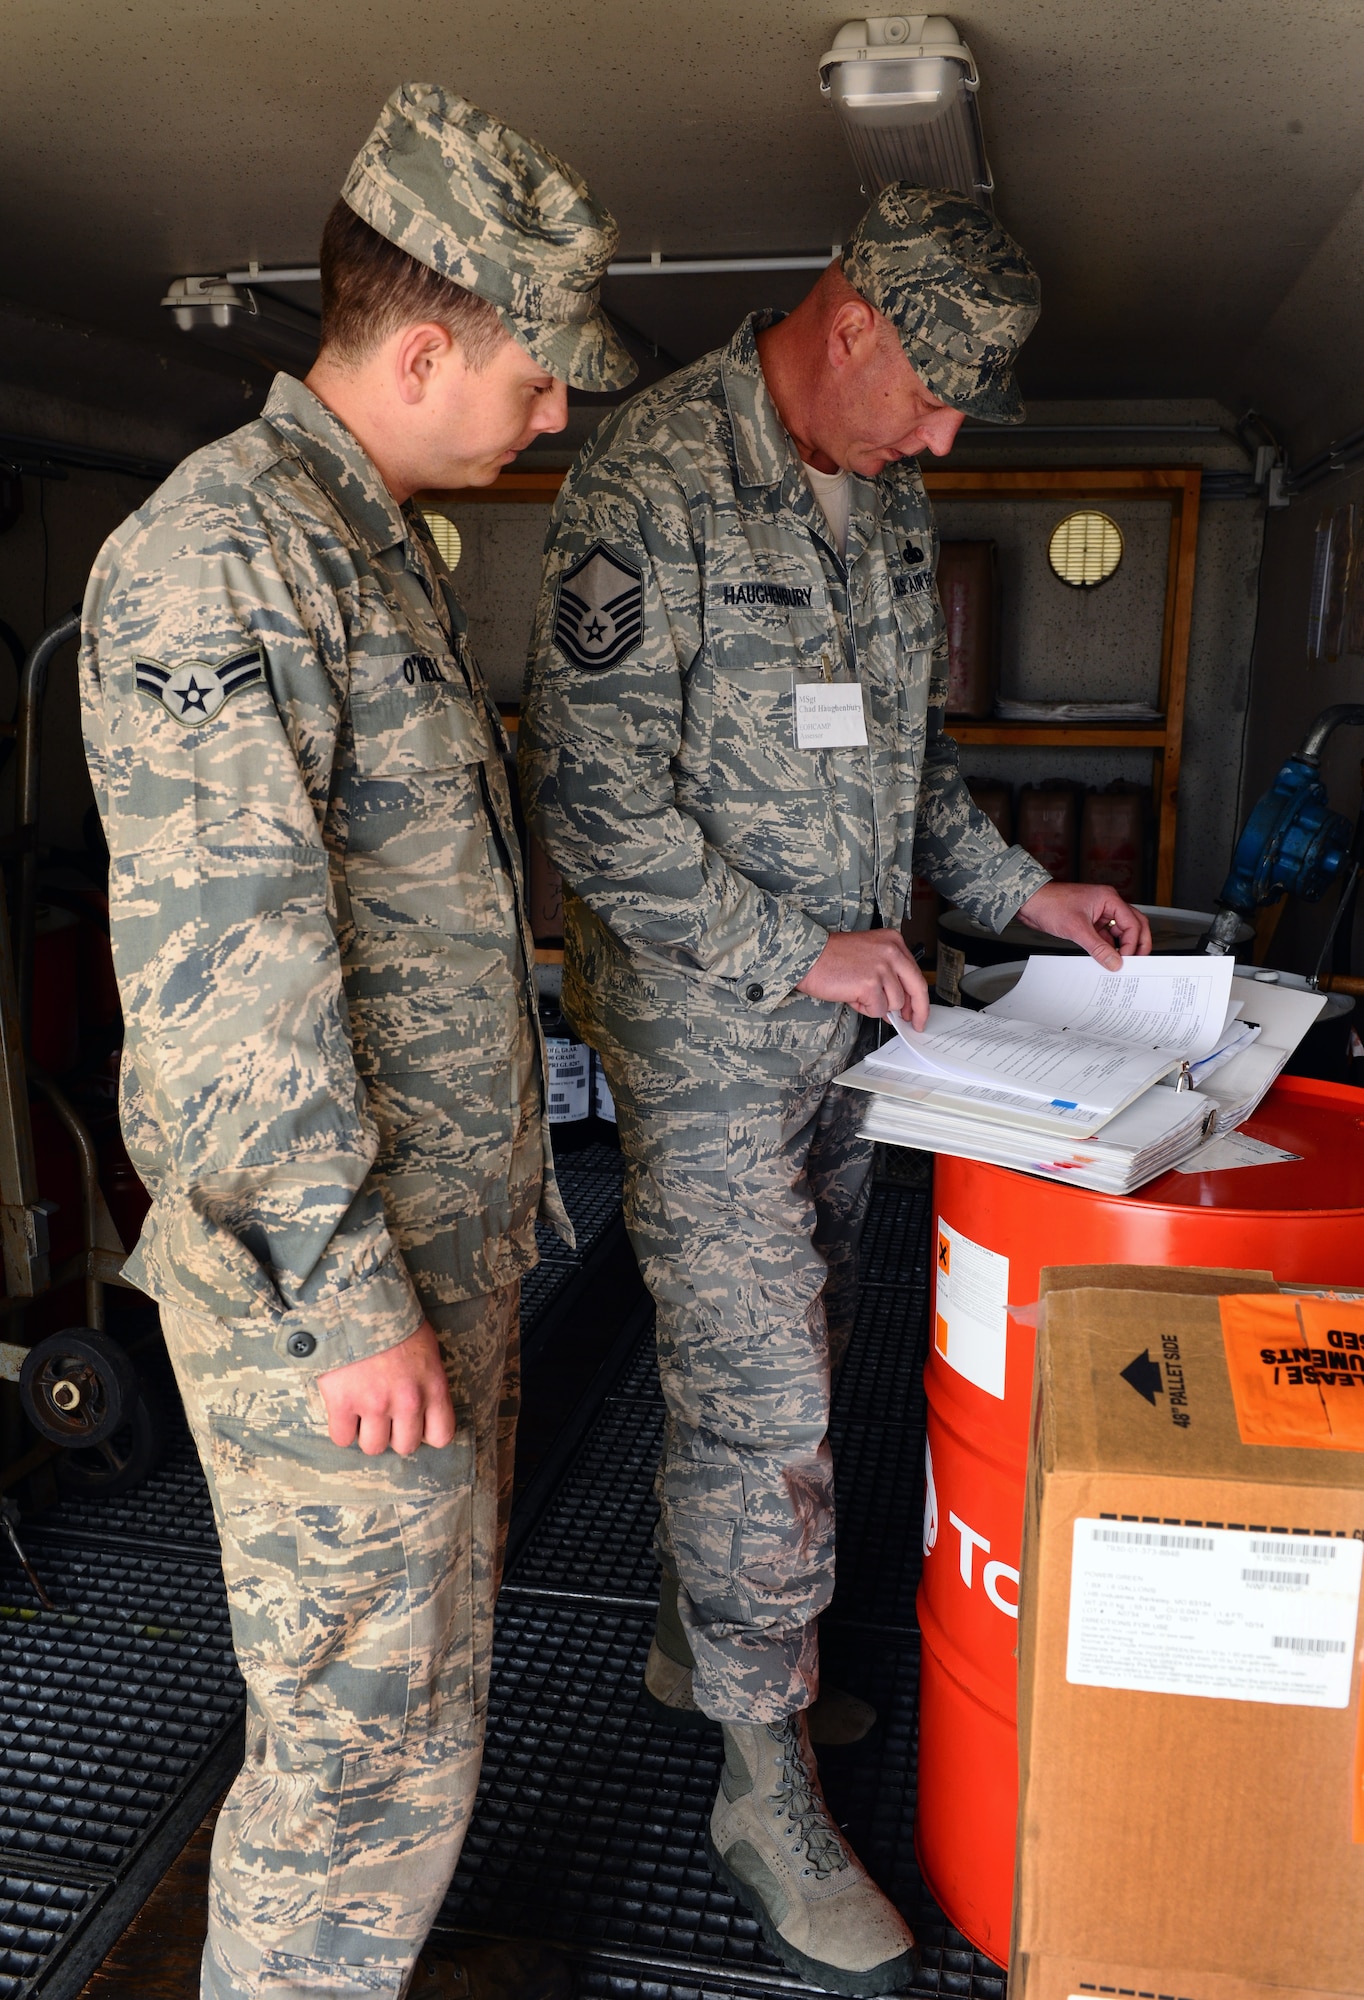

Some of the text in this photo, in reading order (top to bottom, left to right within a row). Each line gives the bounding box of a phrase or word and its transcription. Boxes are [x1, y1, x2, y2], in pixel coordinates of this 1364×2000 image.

[908, 573, 925, 593] AIR
[799, 696, 816, 704] MSgt
[799, 704, 861, 713] Chad Haughenbury
[1161, 1334, 1181, 1360] SIDE
[1165, 1362, 1188, 1406] PALLET
[1084, 1571, 1143, 1582] POWER GREEN
